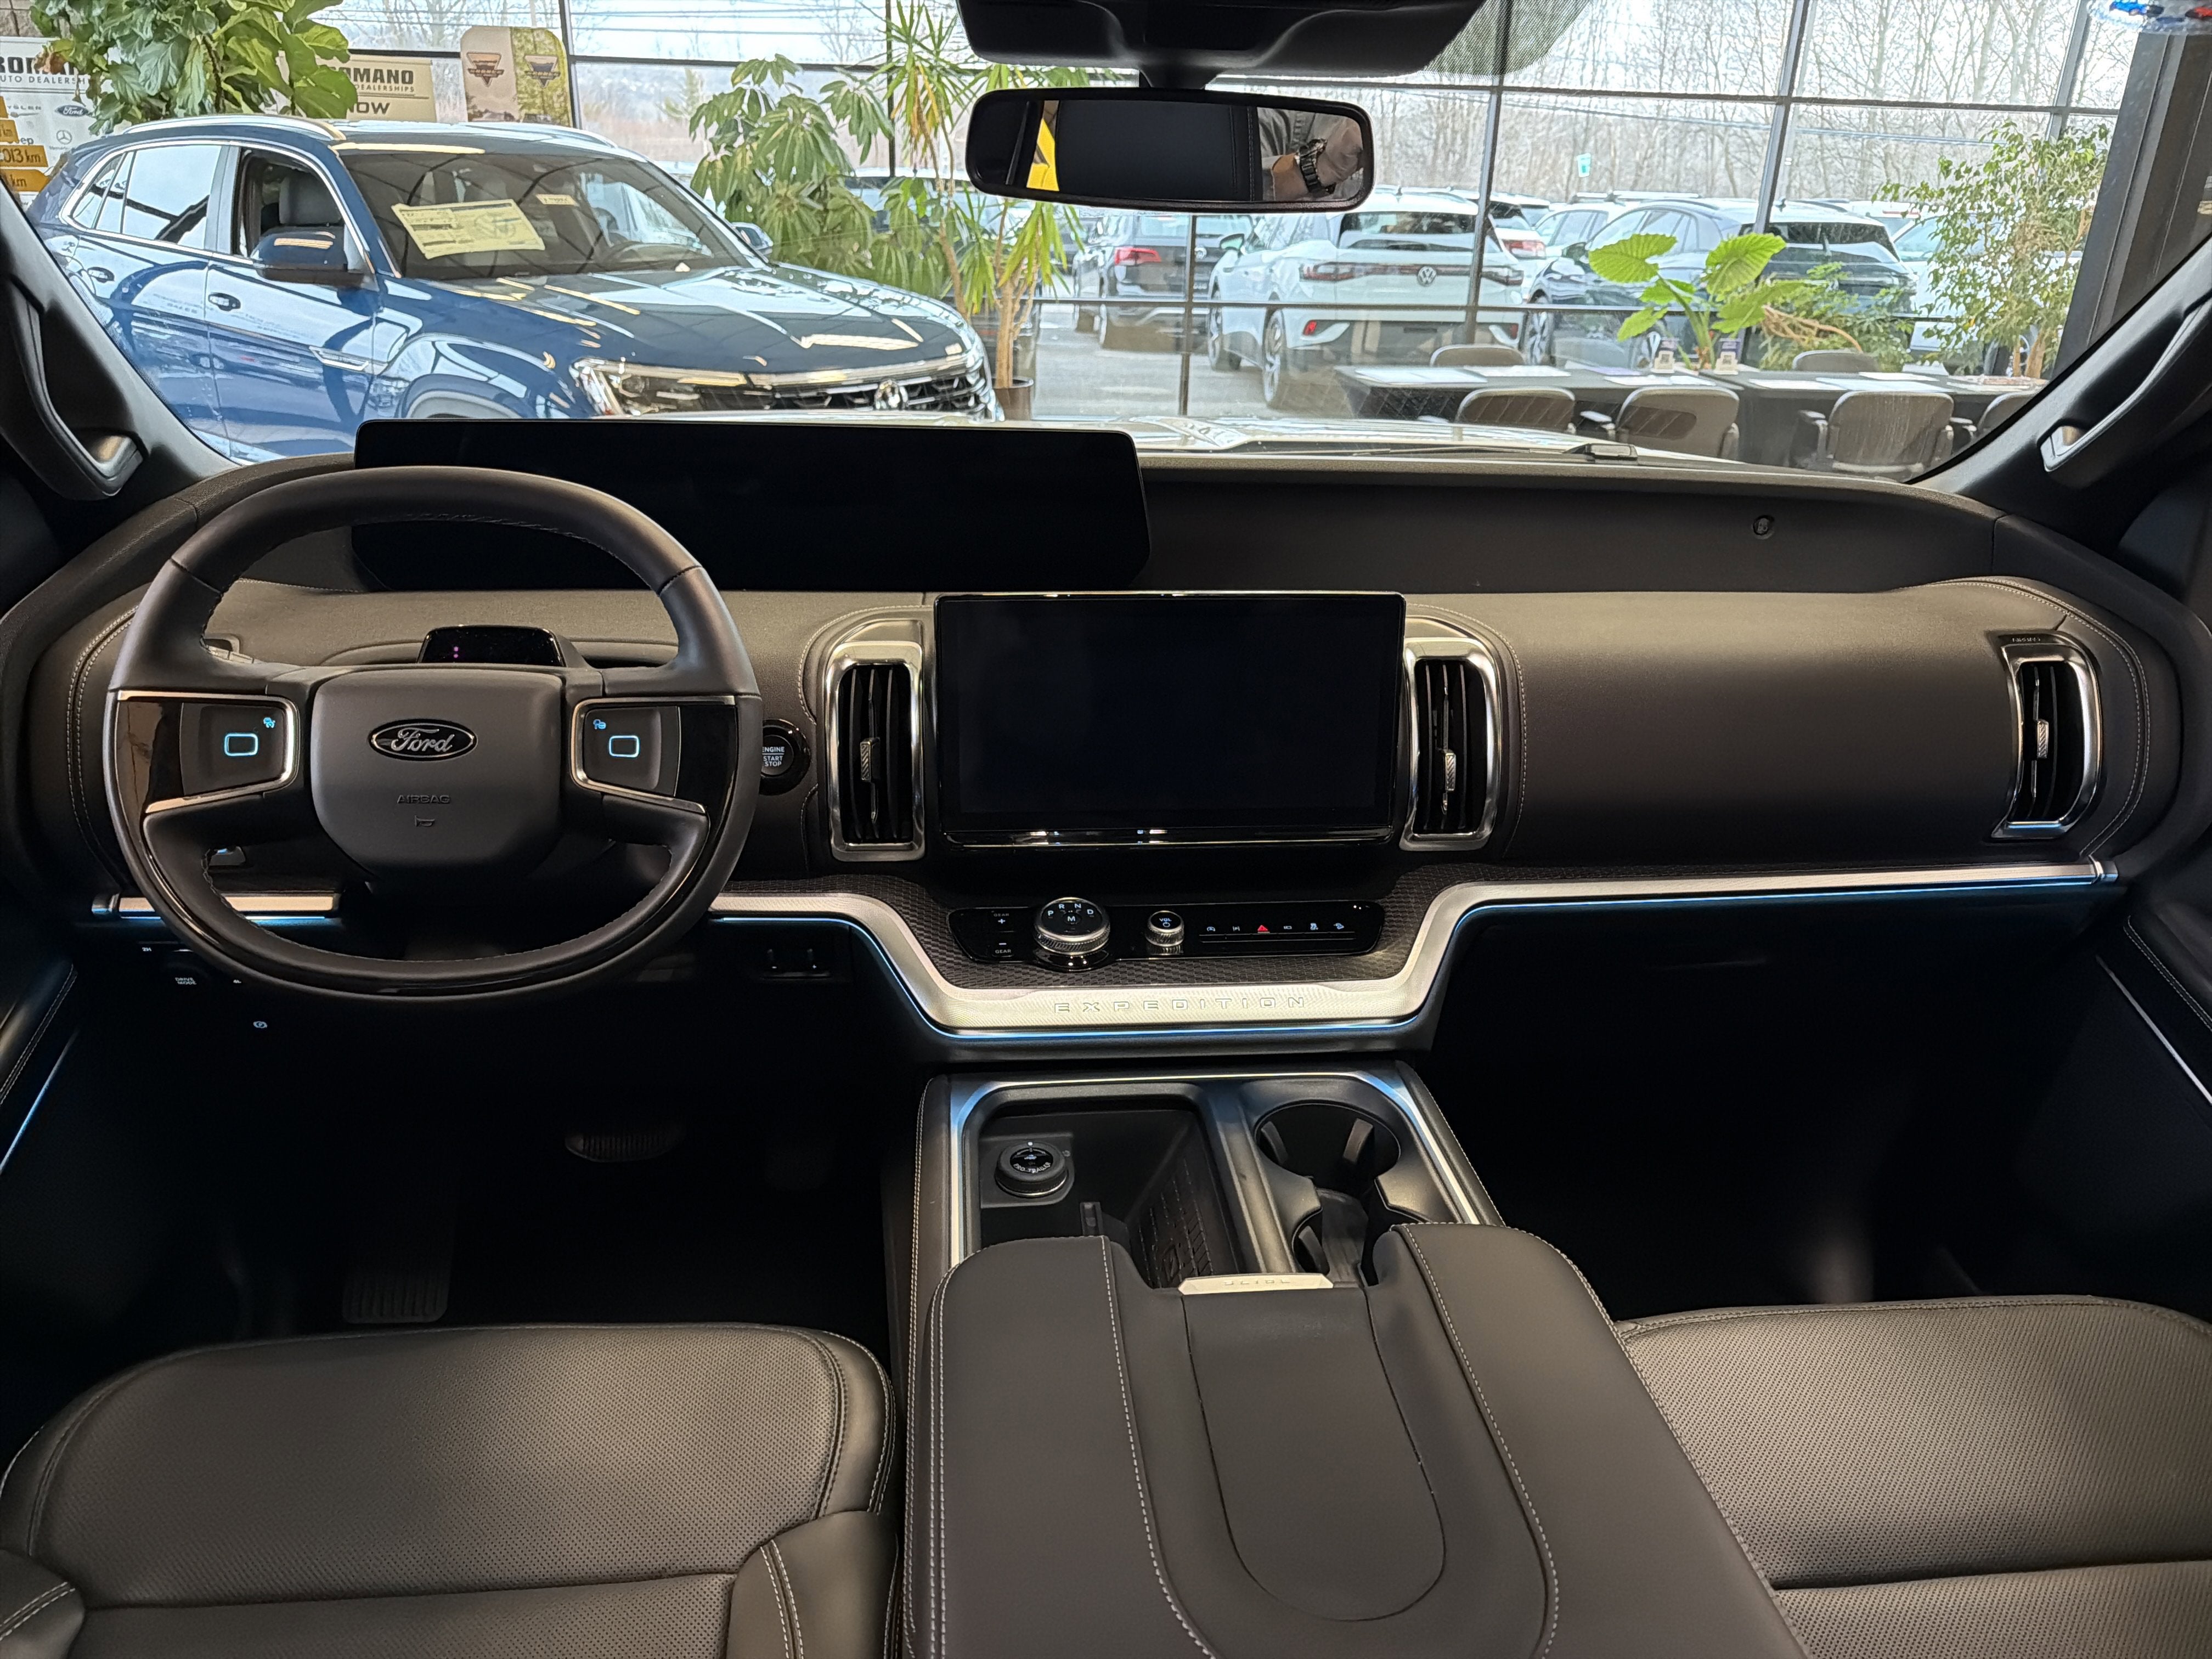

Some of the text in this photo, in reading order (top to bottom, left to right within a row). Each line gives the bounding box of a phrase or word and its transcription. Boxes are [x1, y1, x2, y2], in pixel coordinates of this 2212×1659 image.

[63, 105, 83, 115] Ford
[391, 727, 455, 752] Ford
[397, 794, 450, 804] AIRBAG
[1054, 997, 1305, 1013] EXPEDITION
[1013, 1163, 1026, 1171] PRO
[1027, 1162, 1051, 1173] TRAILER
